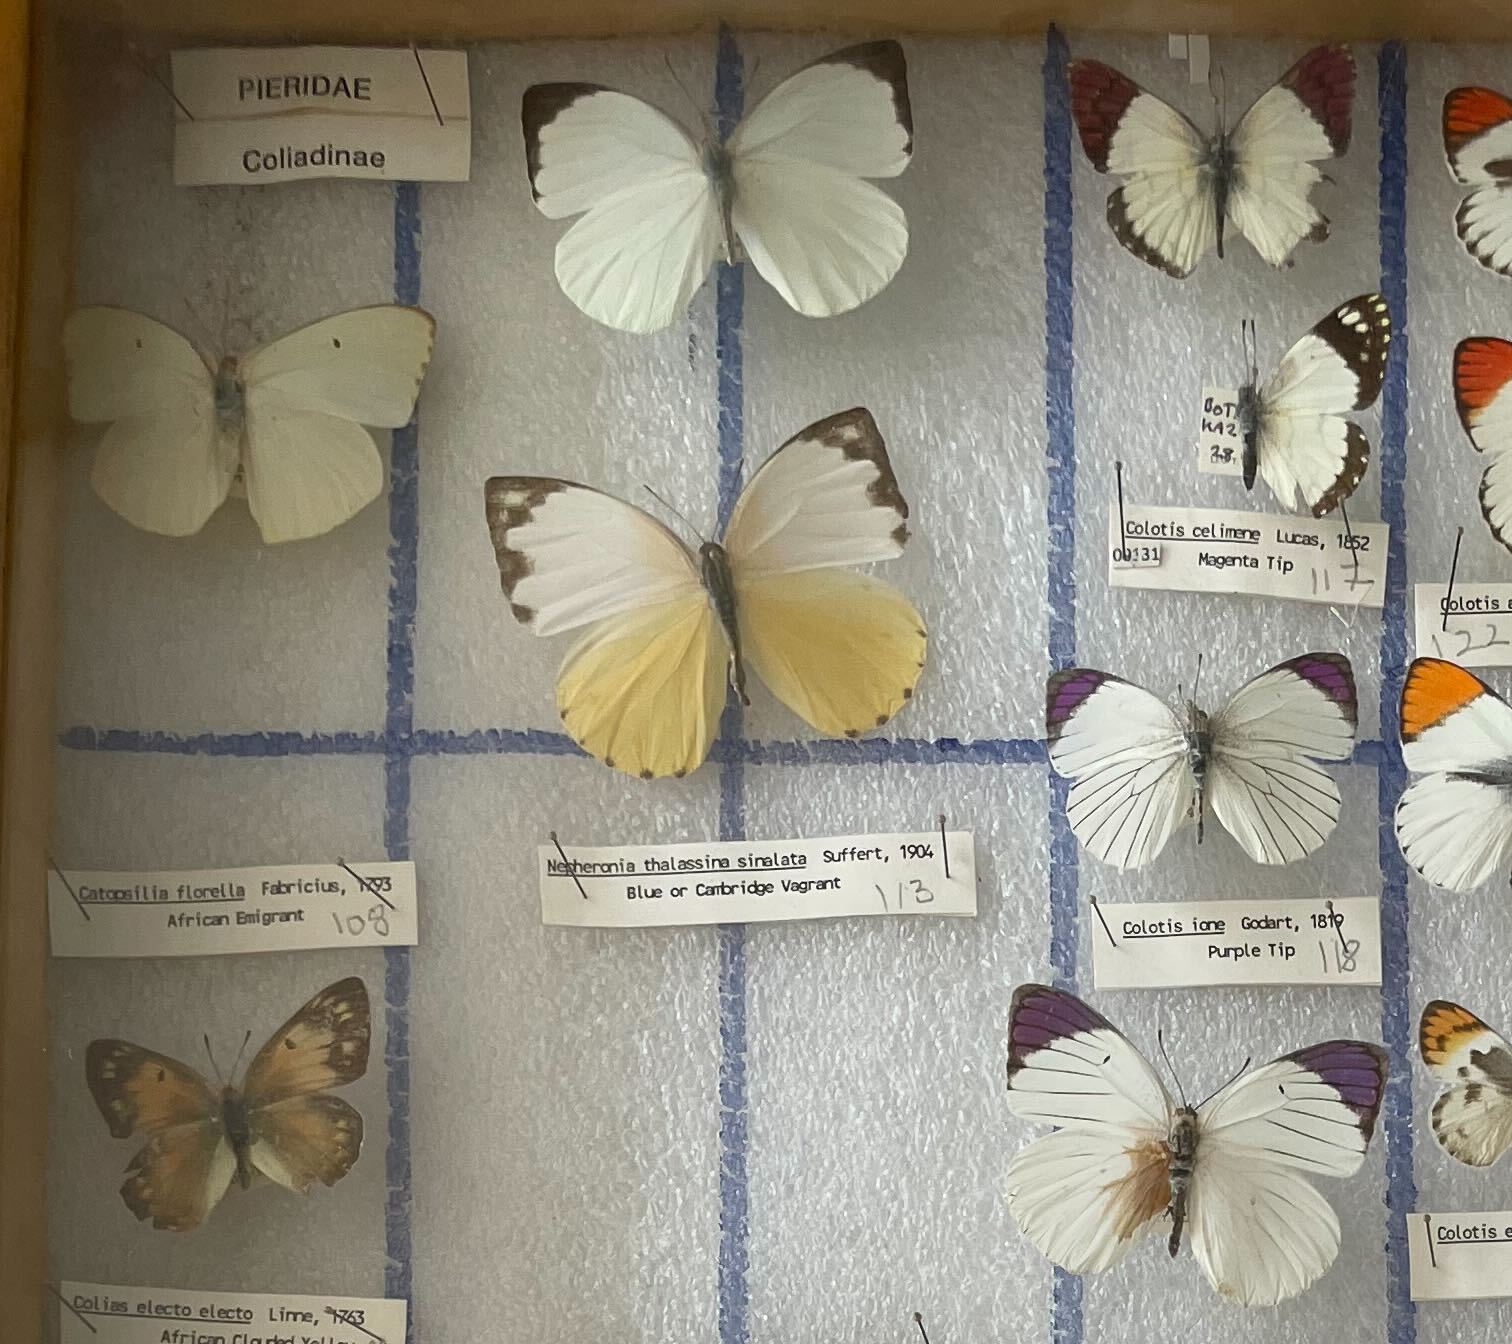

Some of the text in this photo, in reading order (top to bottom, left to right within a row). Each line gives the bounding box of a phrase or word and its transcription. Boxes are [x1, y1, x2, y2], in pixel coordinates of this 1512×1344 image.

[239, 76, 371, 100] PIERIDAE
[243, 145, 385, 173] Coliadinae
[1198, 553, 1294, 573] Magenta Tip
[627, 877, 841, 901] Blue or Cambridge Vagrant
[875, 880, 934, 911] 113
[168, 909, 305, 927] African Emigrant
[1208, 944, 1295, 961] Purple Tip
